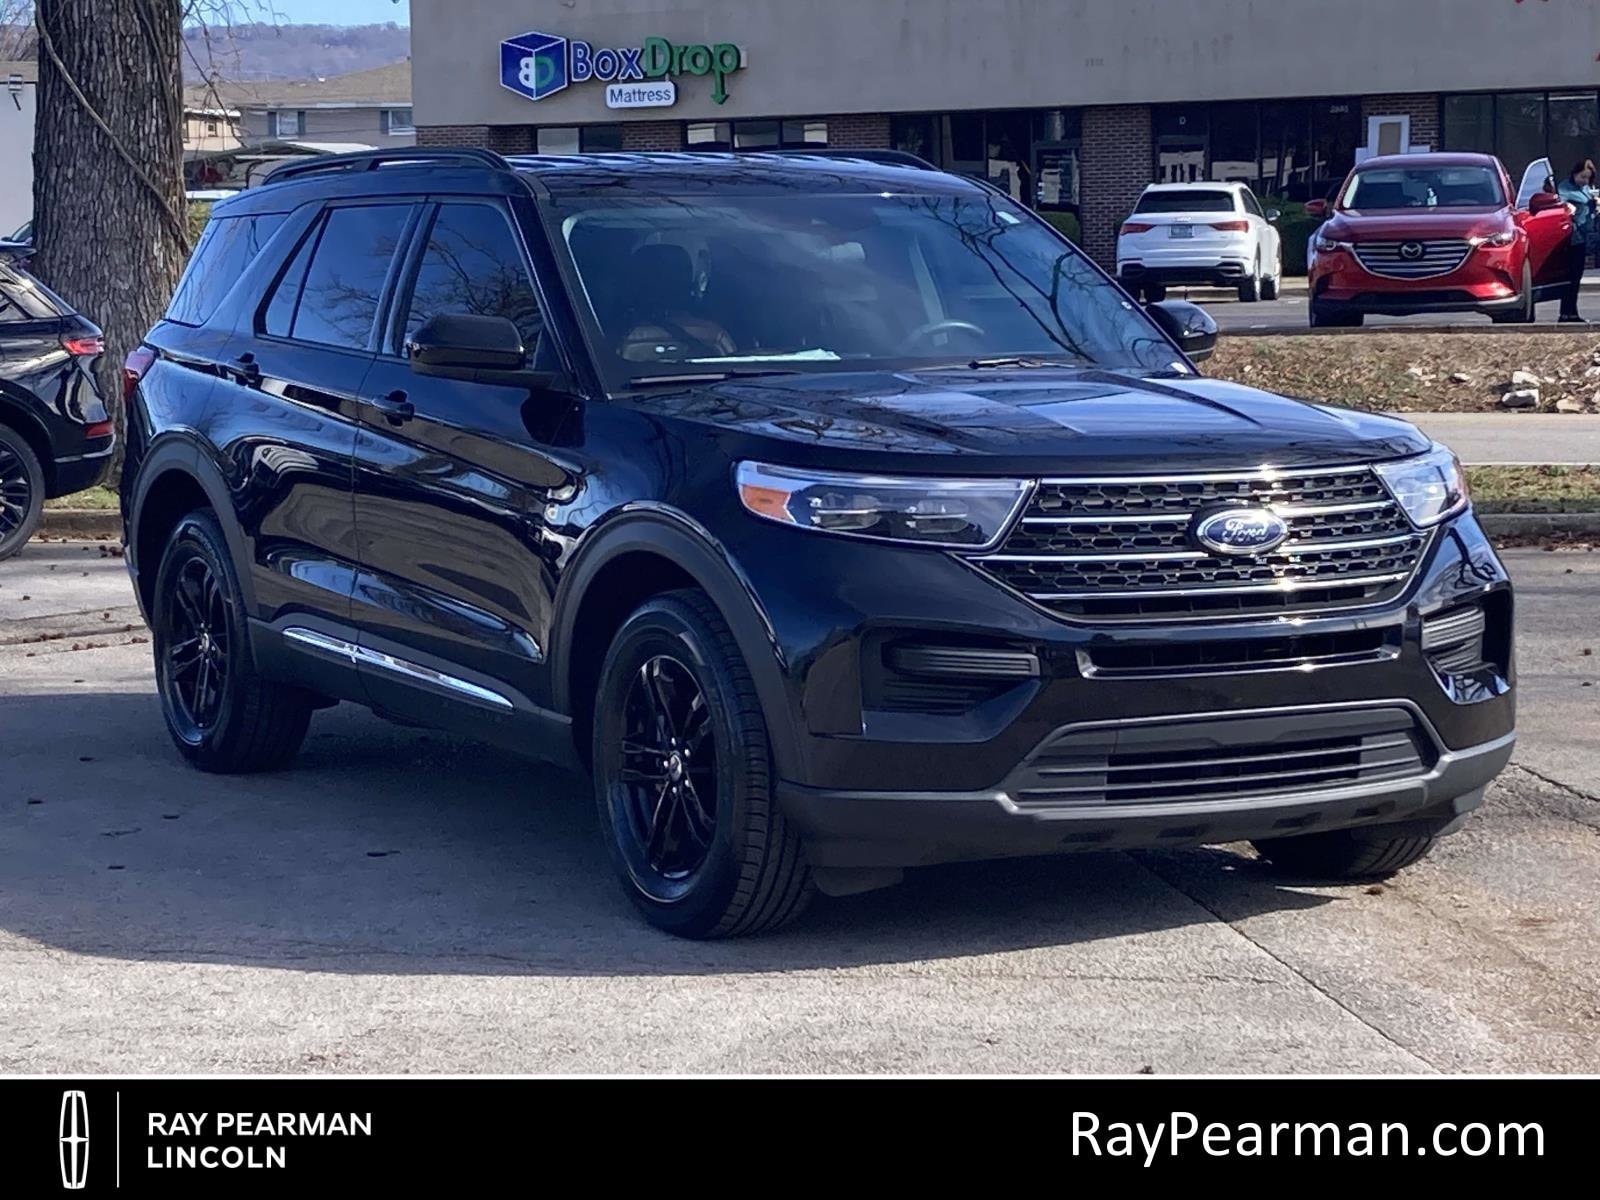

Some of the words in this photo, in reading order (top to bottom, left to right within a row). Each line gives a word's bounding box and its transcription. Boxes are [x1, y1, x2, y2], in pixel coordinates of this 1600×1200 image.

[571, 37, 741, 104] BoxDrop
[609, 87, 671, 103] Mattress
[1222, 519, 1269, 539] Ford
